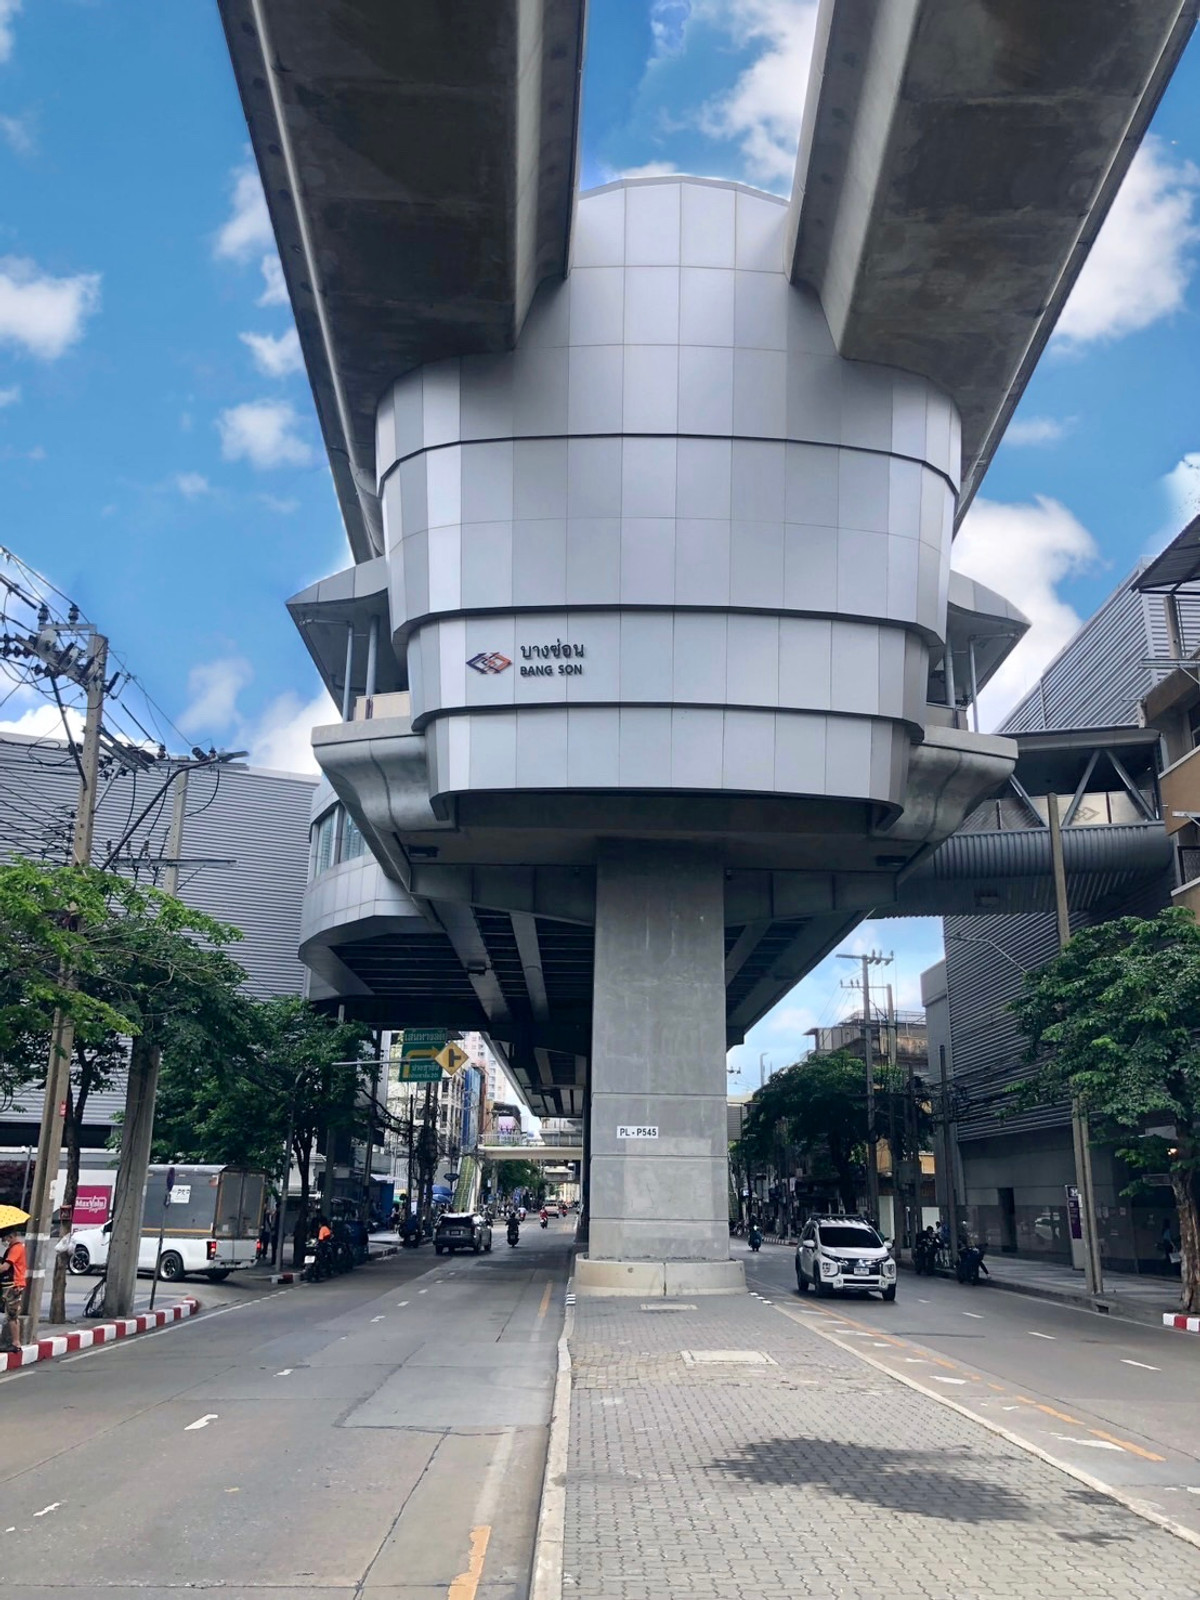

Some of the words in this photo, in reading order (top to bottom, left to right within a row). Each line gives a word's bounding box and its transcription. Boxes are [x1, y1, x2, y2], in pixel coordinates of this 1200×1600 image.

[520, 638, 585, 659] บางซ่อน
[520, 665, 553, 676] BANG
[558, 664, 583, 675] SON
